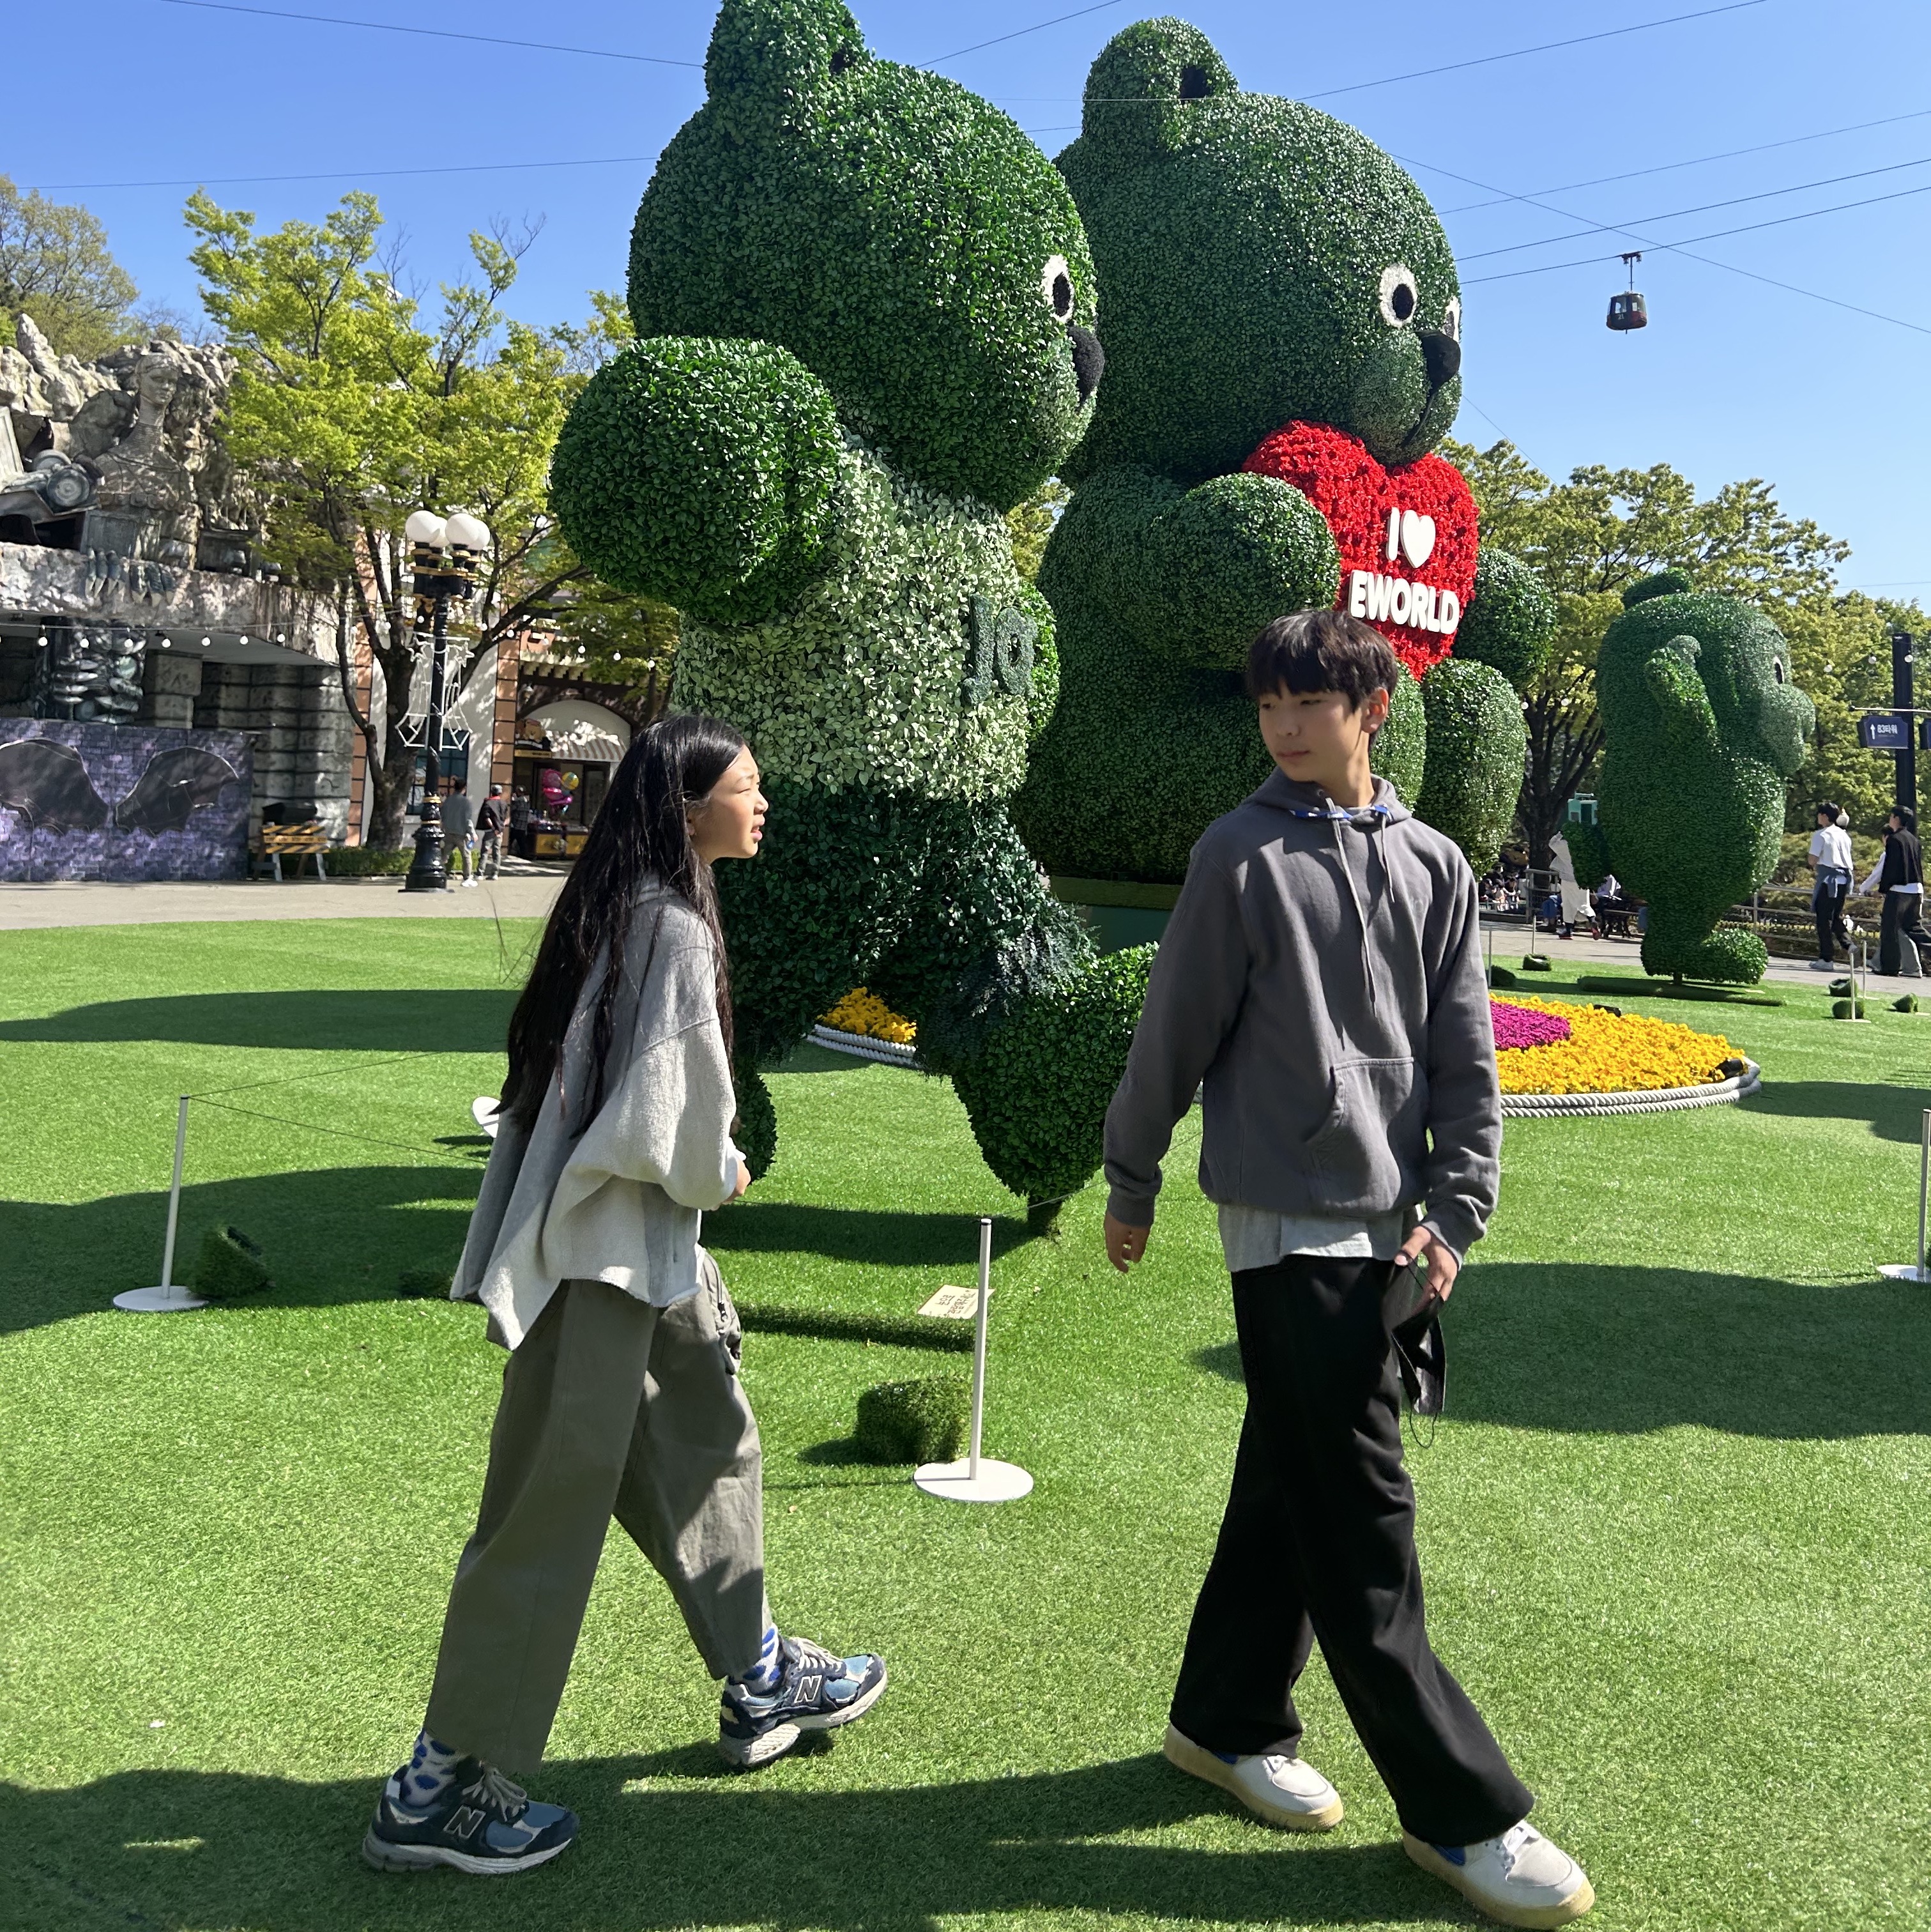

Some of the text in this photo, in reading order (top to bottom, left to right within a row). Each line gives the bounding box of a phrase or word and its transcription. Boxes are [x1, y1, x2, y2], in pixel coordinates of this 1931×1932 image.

[1386, 507, 1400, 561] I
[1348, 569, 1460, 634] EWORLD
[793, 1675, 822, 1704] N
[443, 1804, 486, 1840] N
